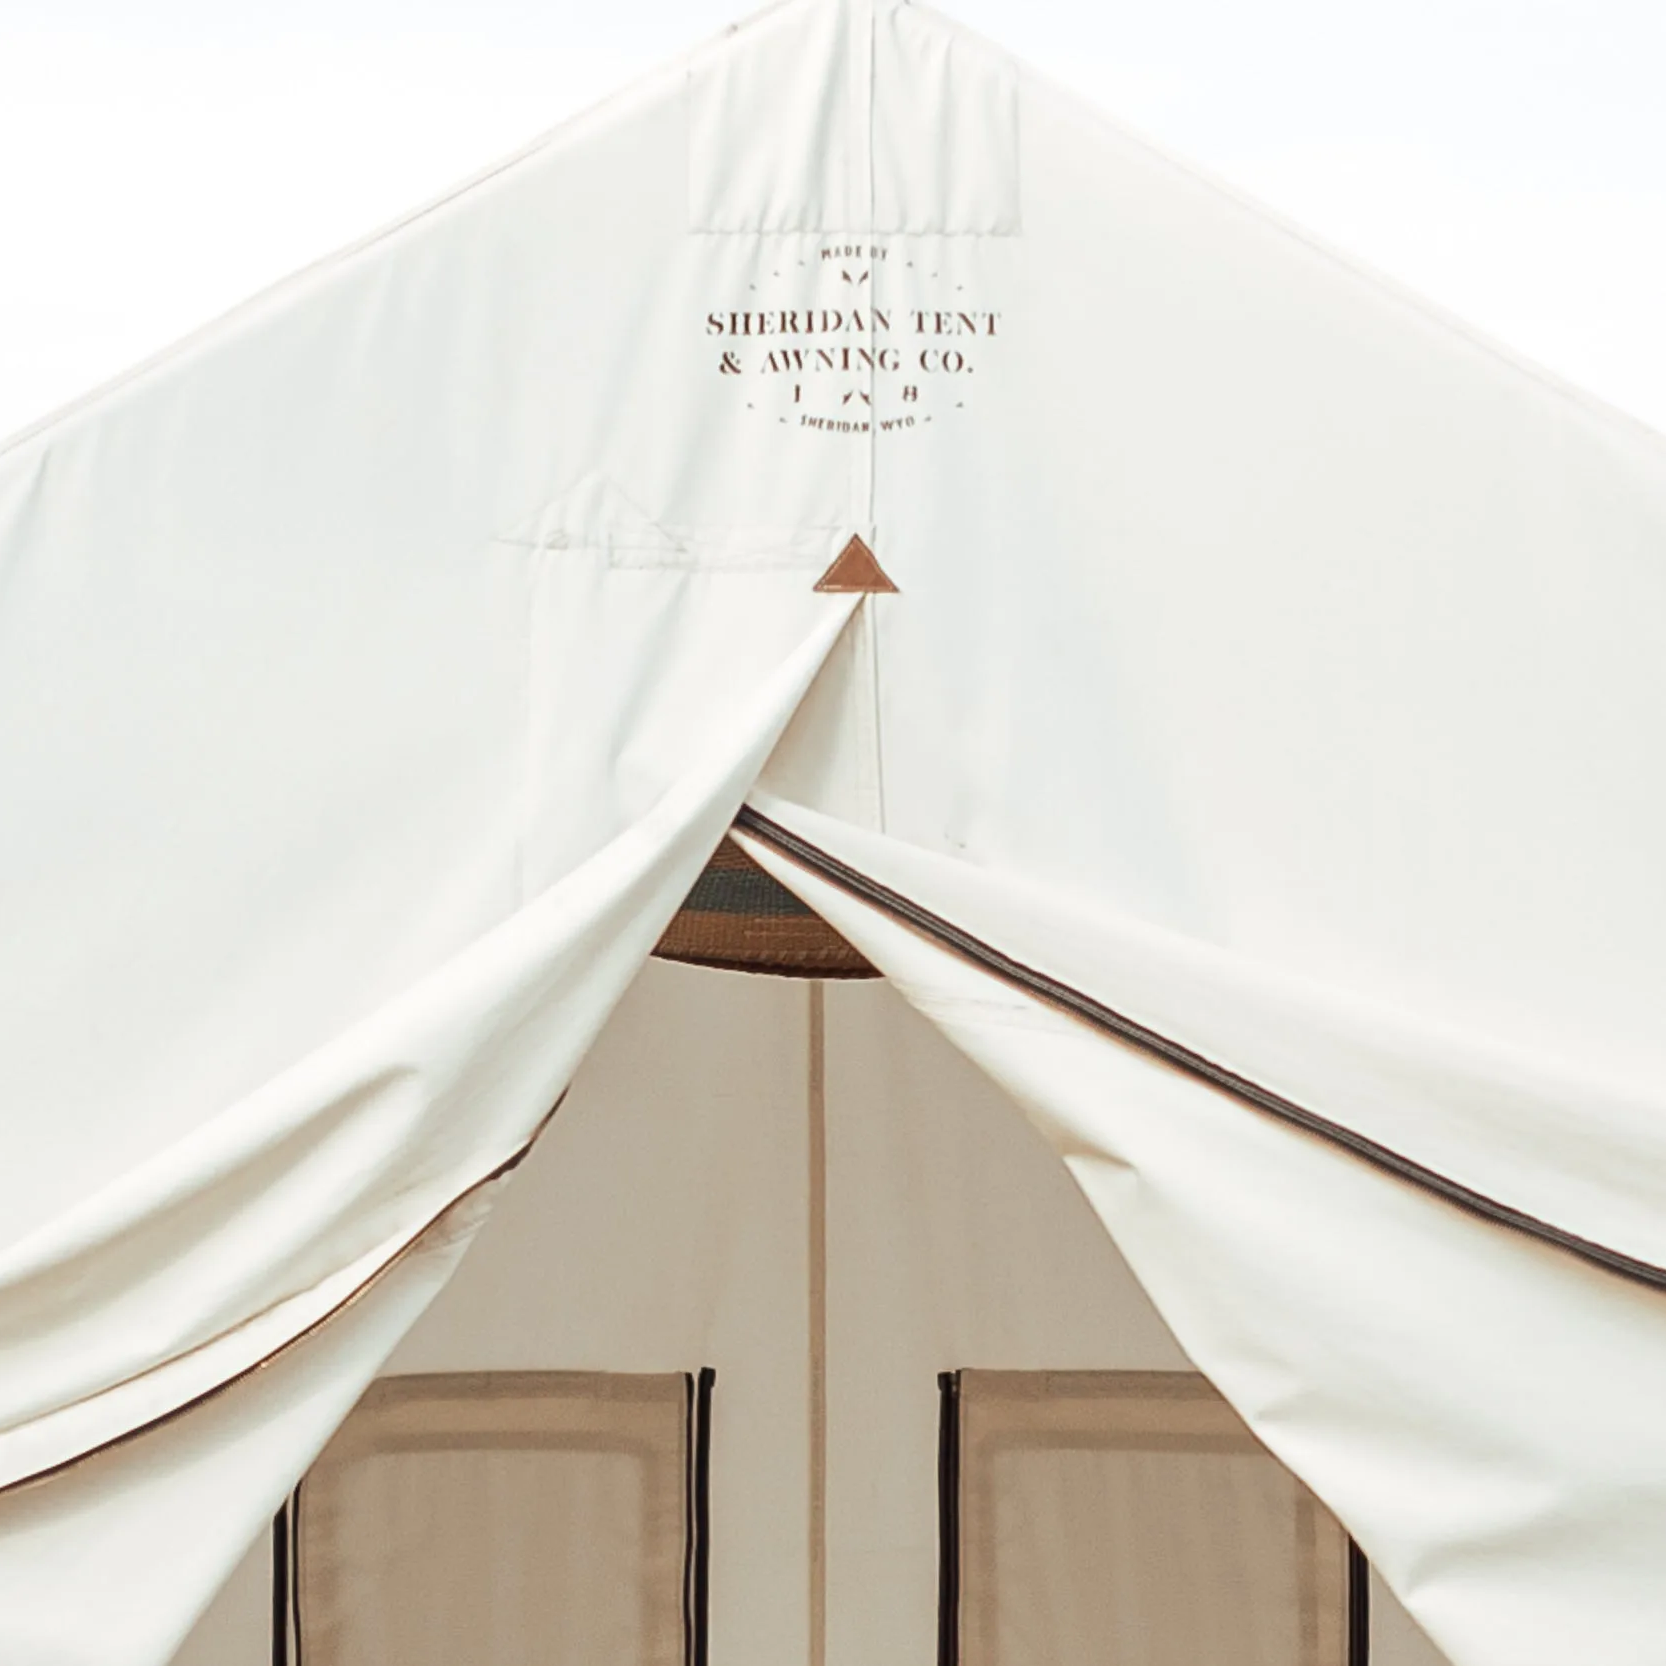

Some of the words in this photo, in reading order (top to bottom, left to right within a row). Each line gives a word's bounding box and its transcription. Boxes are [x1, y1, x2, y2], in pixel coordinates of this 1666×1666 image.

[821, 245, 862, 261] MADE
[706, 309, 891, 336] SHERIDAN
[910, 310, 1002, 336] TENT
[719, 351, 742, 374] &
[761, 347, 900, 374] AWNING
[919, 349, 974, 374] CO.
[880, 415, 916, 432] WYO
